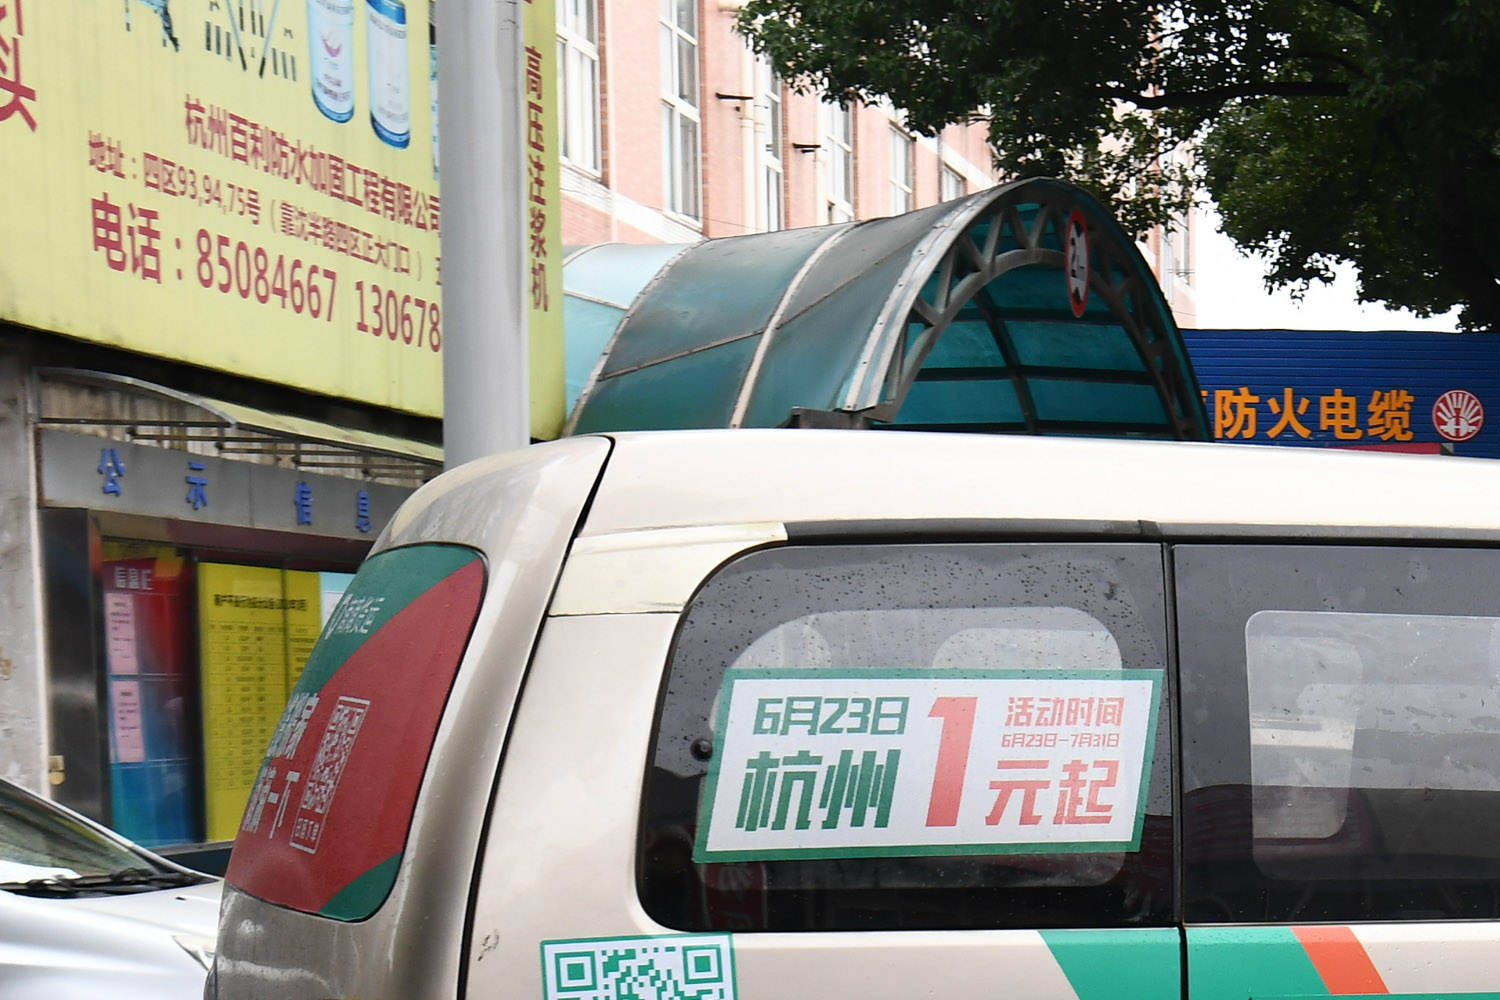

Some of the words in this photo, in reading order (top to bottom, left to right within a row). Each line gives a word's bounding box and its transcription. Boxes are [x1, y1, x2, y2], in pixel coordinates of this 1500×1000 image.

[524, 46, 549, 312] 高压注浆机
[1200, 387, 1415, 441] 防火电缆
[753, 696, 910, 735] 6月23日
[1005, 697, 1124, 726] 活动时间
[735, 749, 902, 832] 杭州
